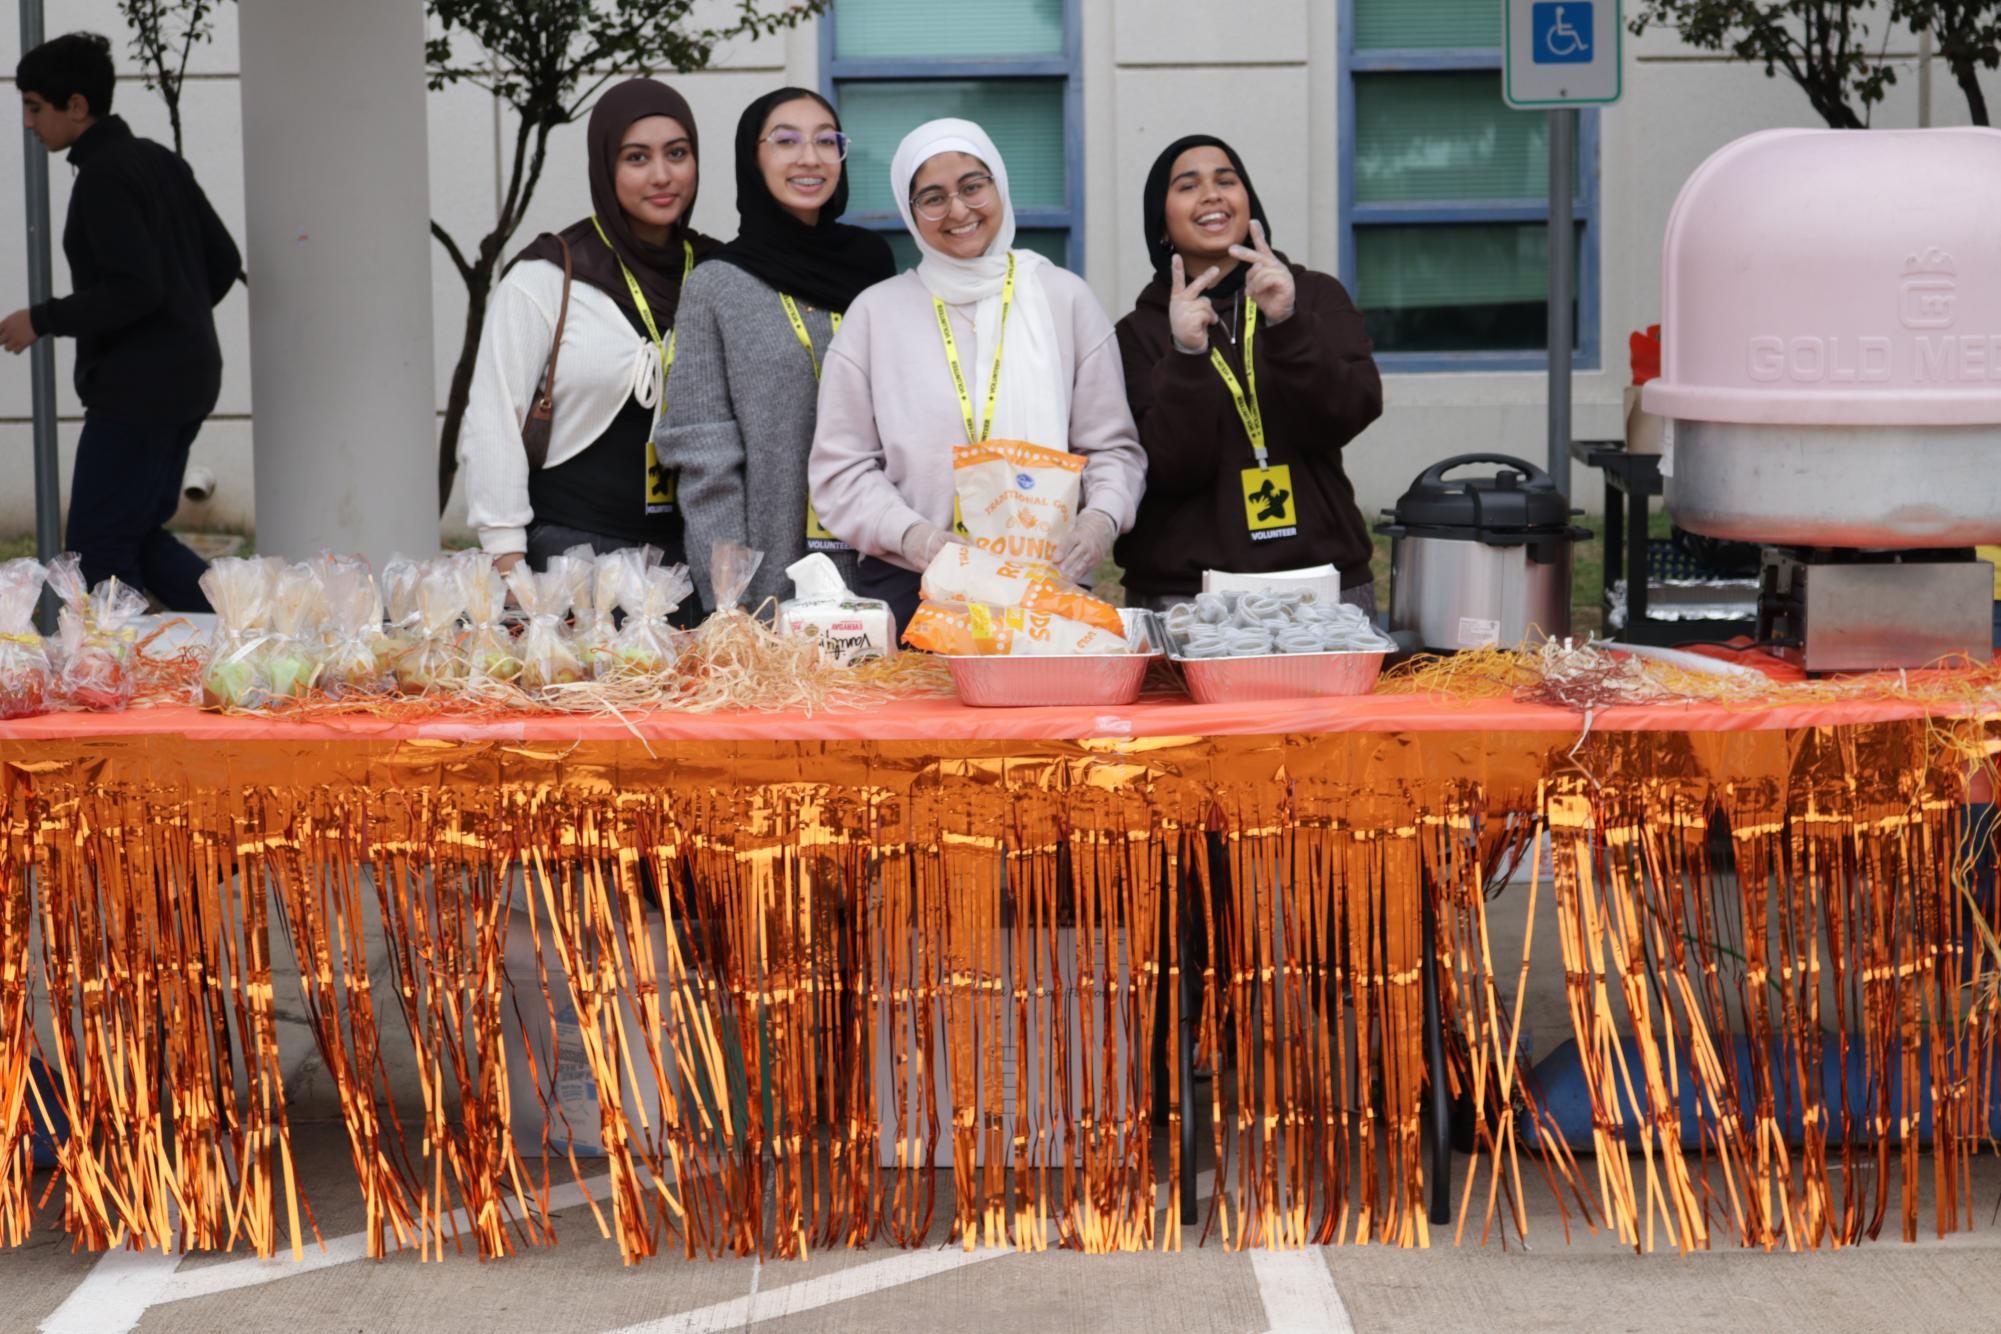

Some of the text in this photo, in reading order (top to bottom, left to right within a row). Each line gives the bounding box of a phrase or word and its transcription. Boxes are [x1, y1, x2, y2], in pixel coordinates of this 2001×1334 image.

[1747, 335, 1893, 383] GOLD
[807, 540, 850, 550] VOLUNTEE
[974, 534, 1057, 561] ROUND
[1251, 527, 1297, 541] VOLUNTEER
[825, 629, 872, 661] Vanity
